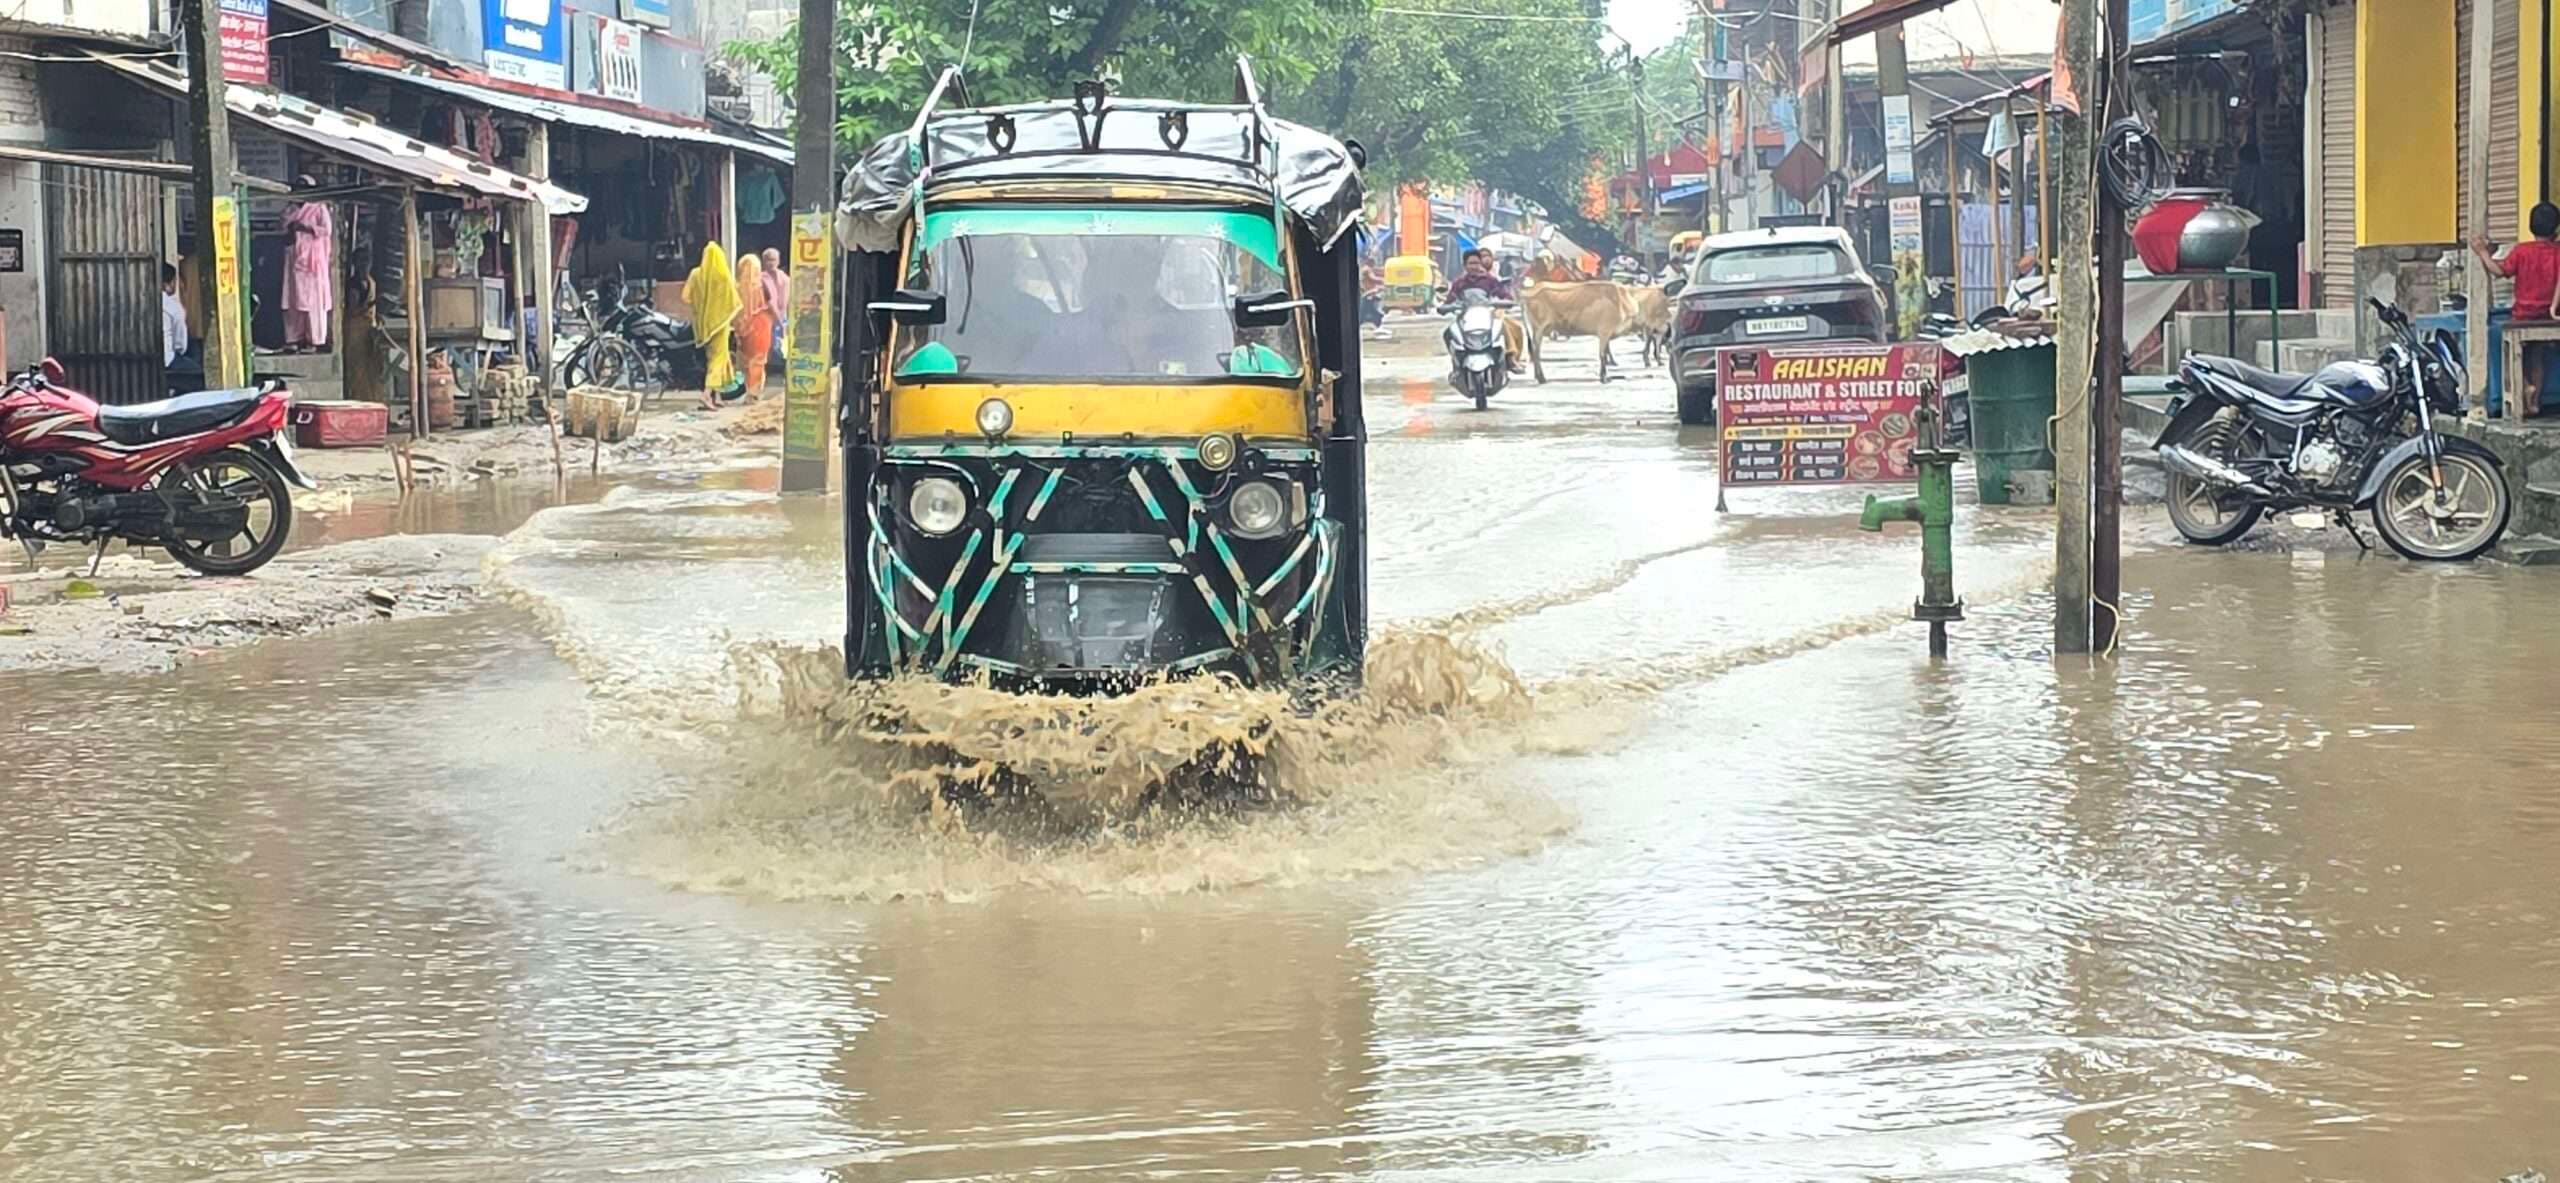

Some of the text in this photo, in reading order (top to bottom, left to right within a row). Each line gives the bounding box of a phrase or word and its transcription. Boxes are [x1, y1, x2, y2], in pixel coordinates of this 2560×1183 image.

[1772, 357, 1888, 380] AALISHAN
[1725, 382, 1822, 401] RESTAURANT
[1825, 383, 1837, 398] &
[1839, 380, 1894, 398] STREET
